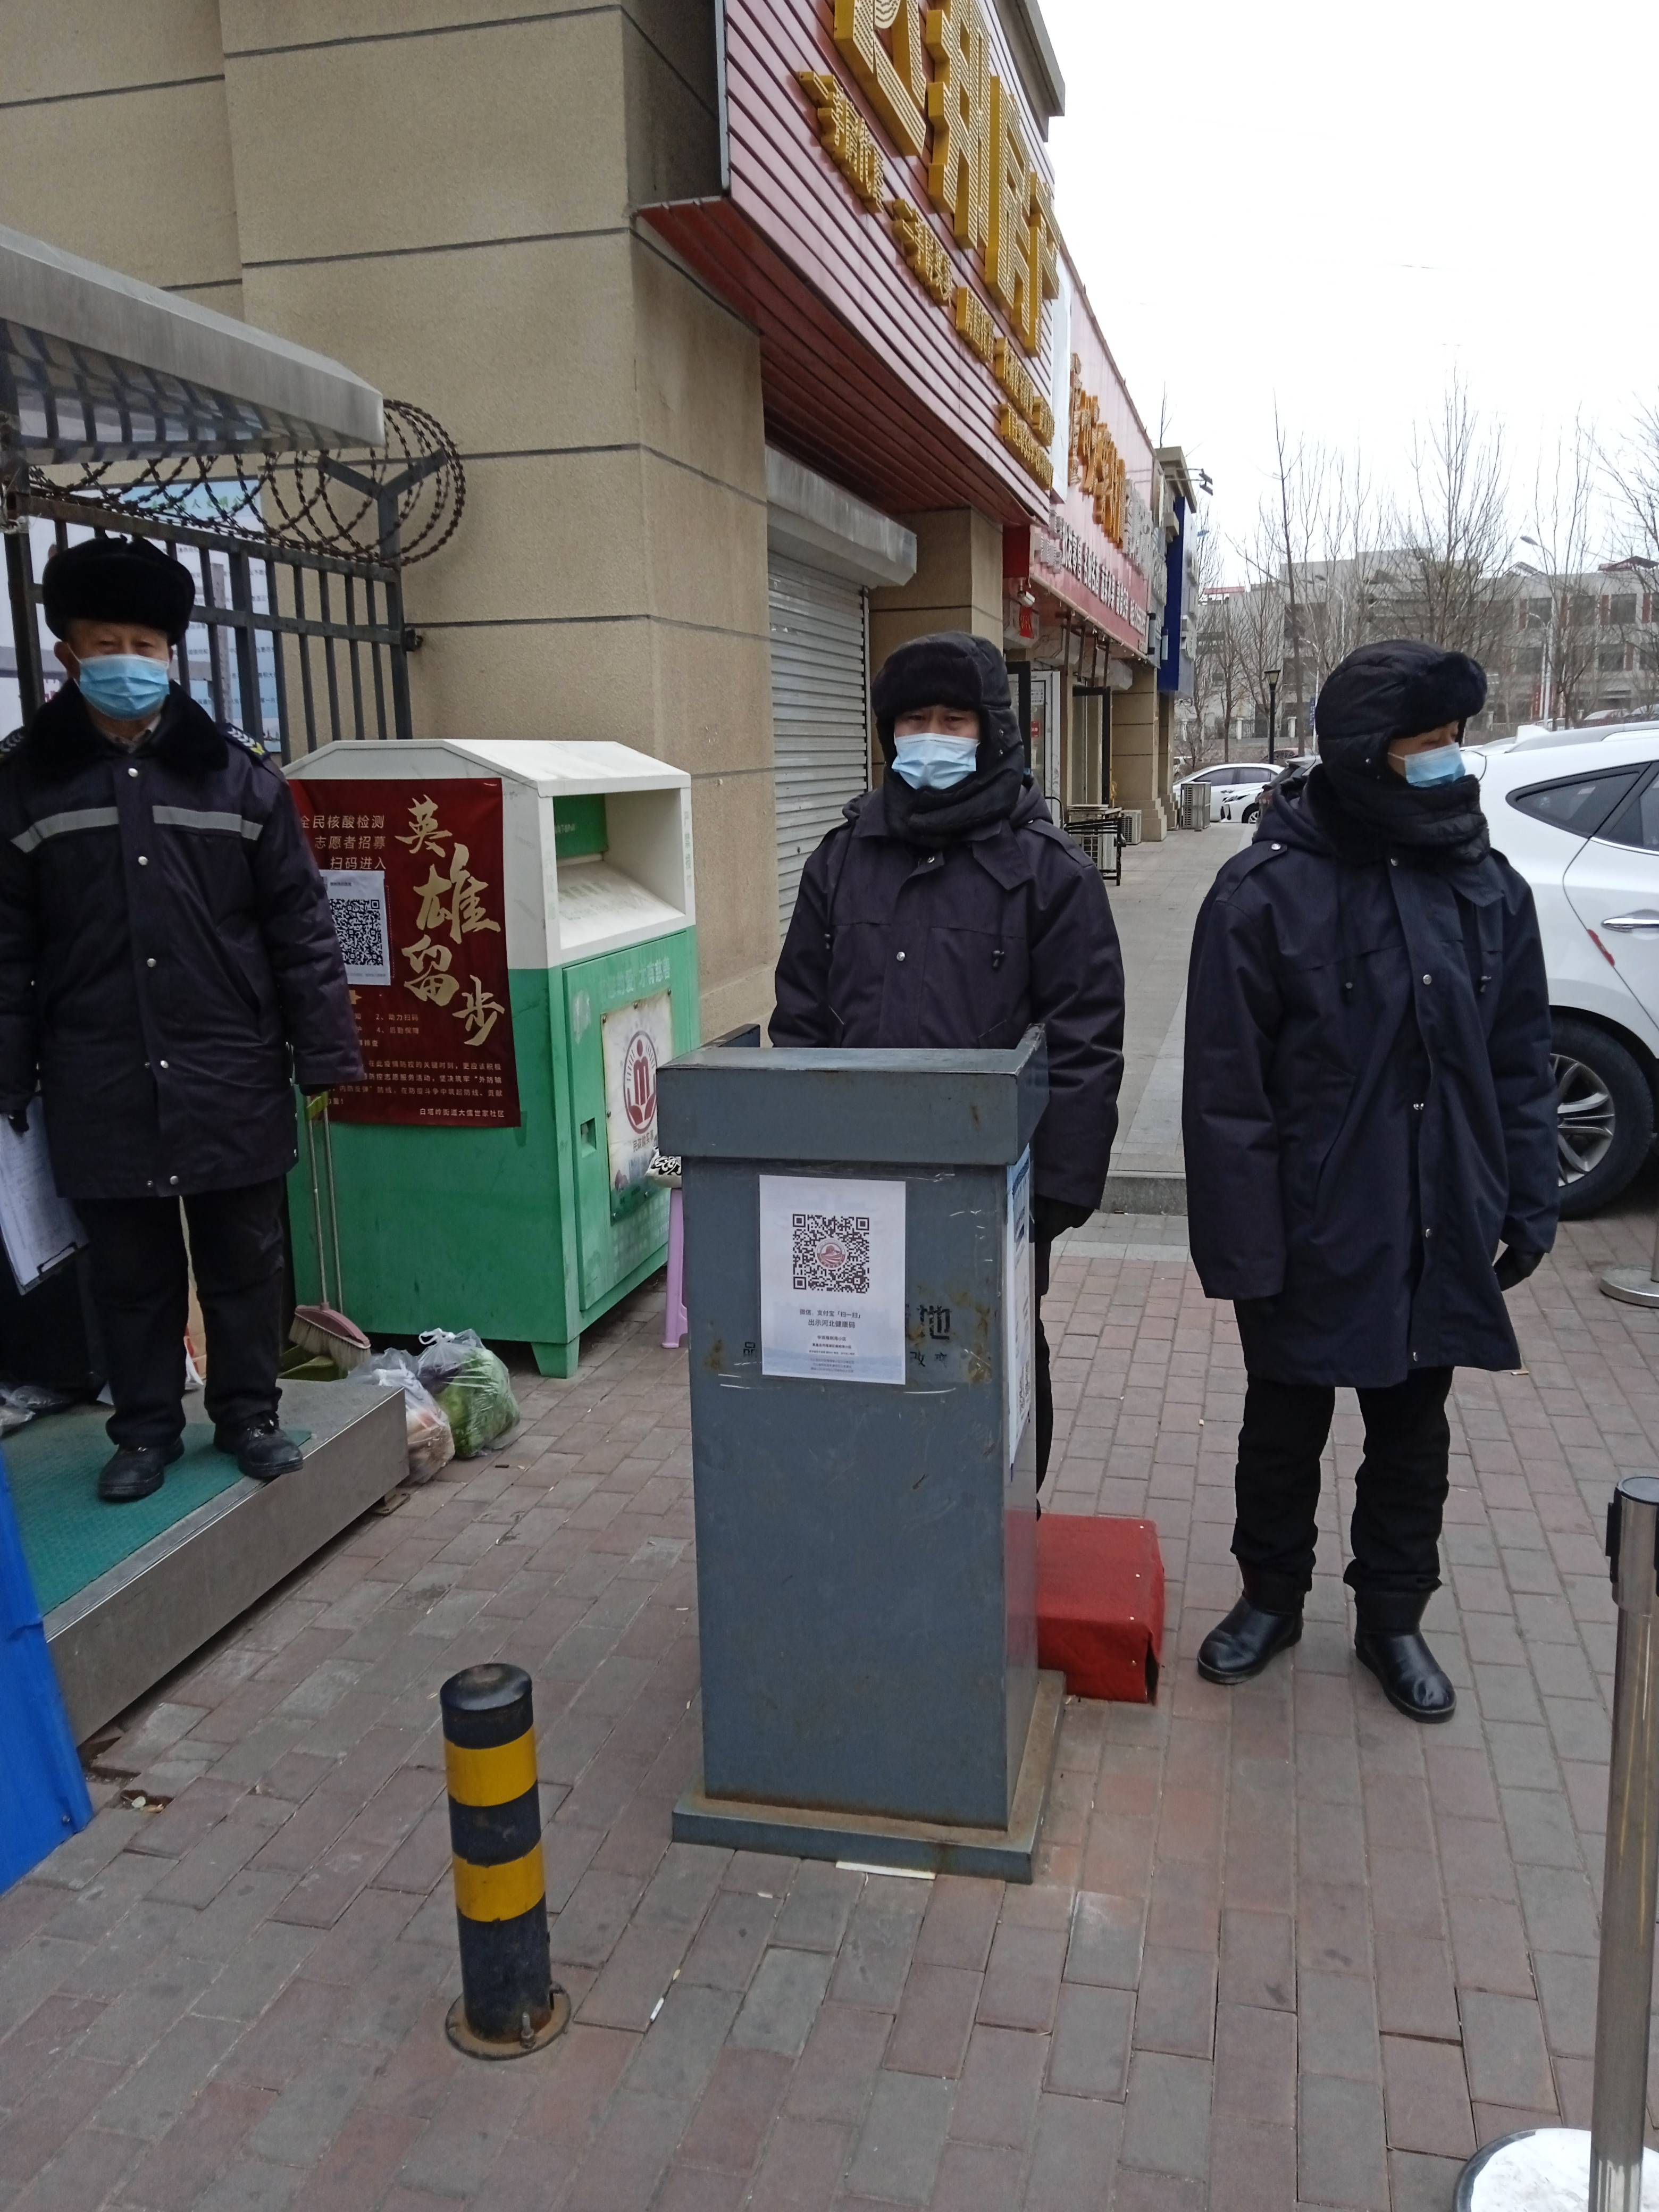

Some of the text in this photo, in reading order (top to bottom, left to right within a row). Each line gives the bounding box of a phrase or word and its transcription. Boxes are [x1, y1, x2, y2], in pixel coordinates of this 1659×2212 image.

[893, 198, 953, 307] 二手房买卖
[301, 815, 384, 828] 全民核酸检测
[315, 836, 386, 849] 志愿者招募
[331, 857, 386, 870] 扫码进入
[396, 794, 505, 1045] 英雄留步
[808, 1319, 856, 1328] 出示河北健康码
